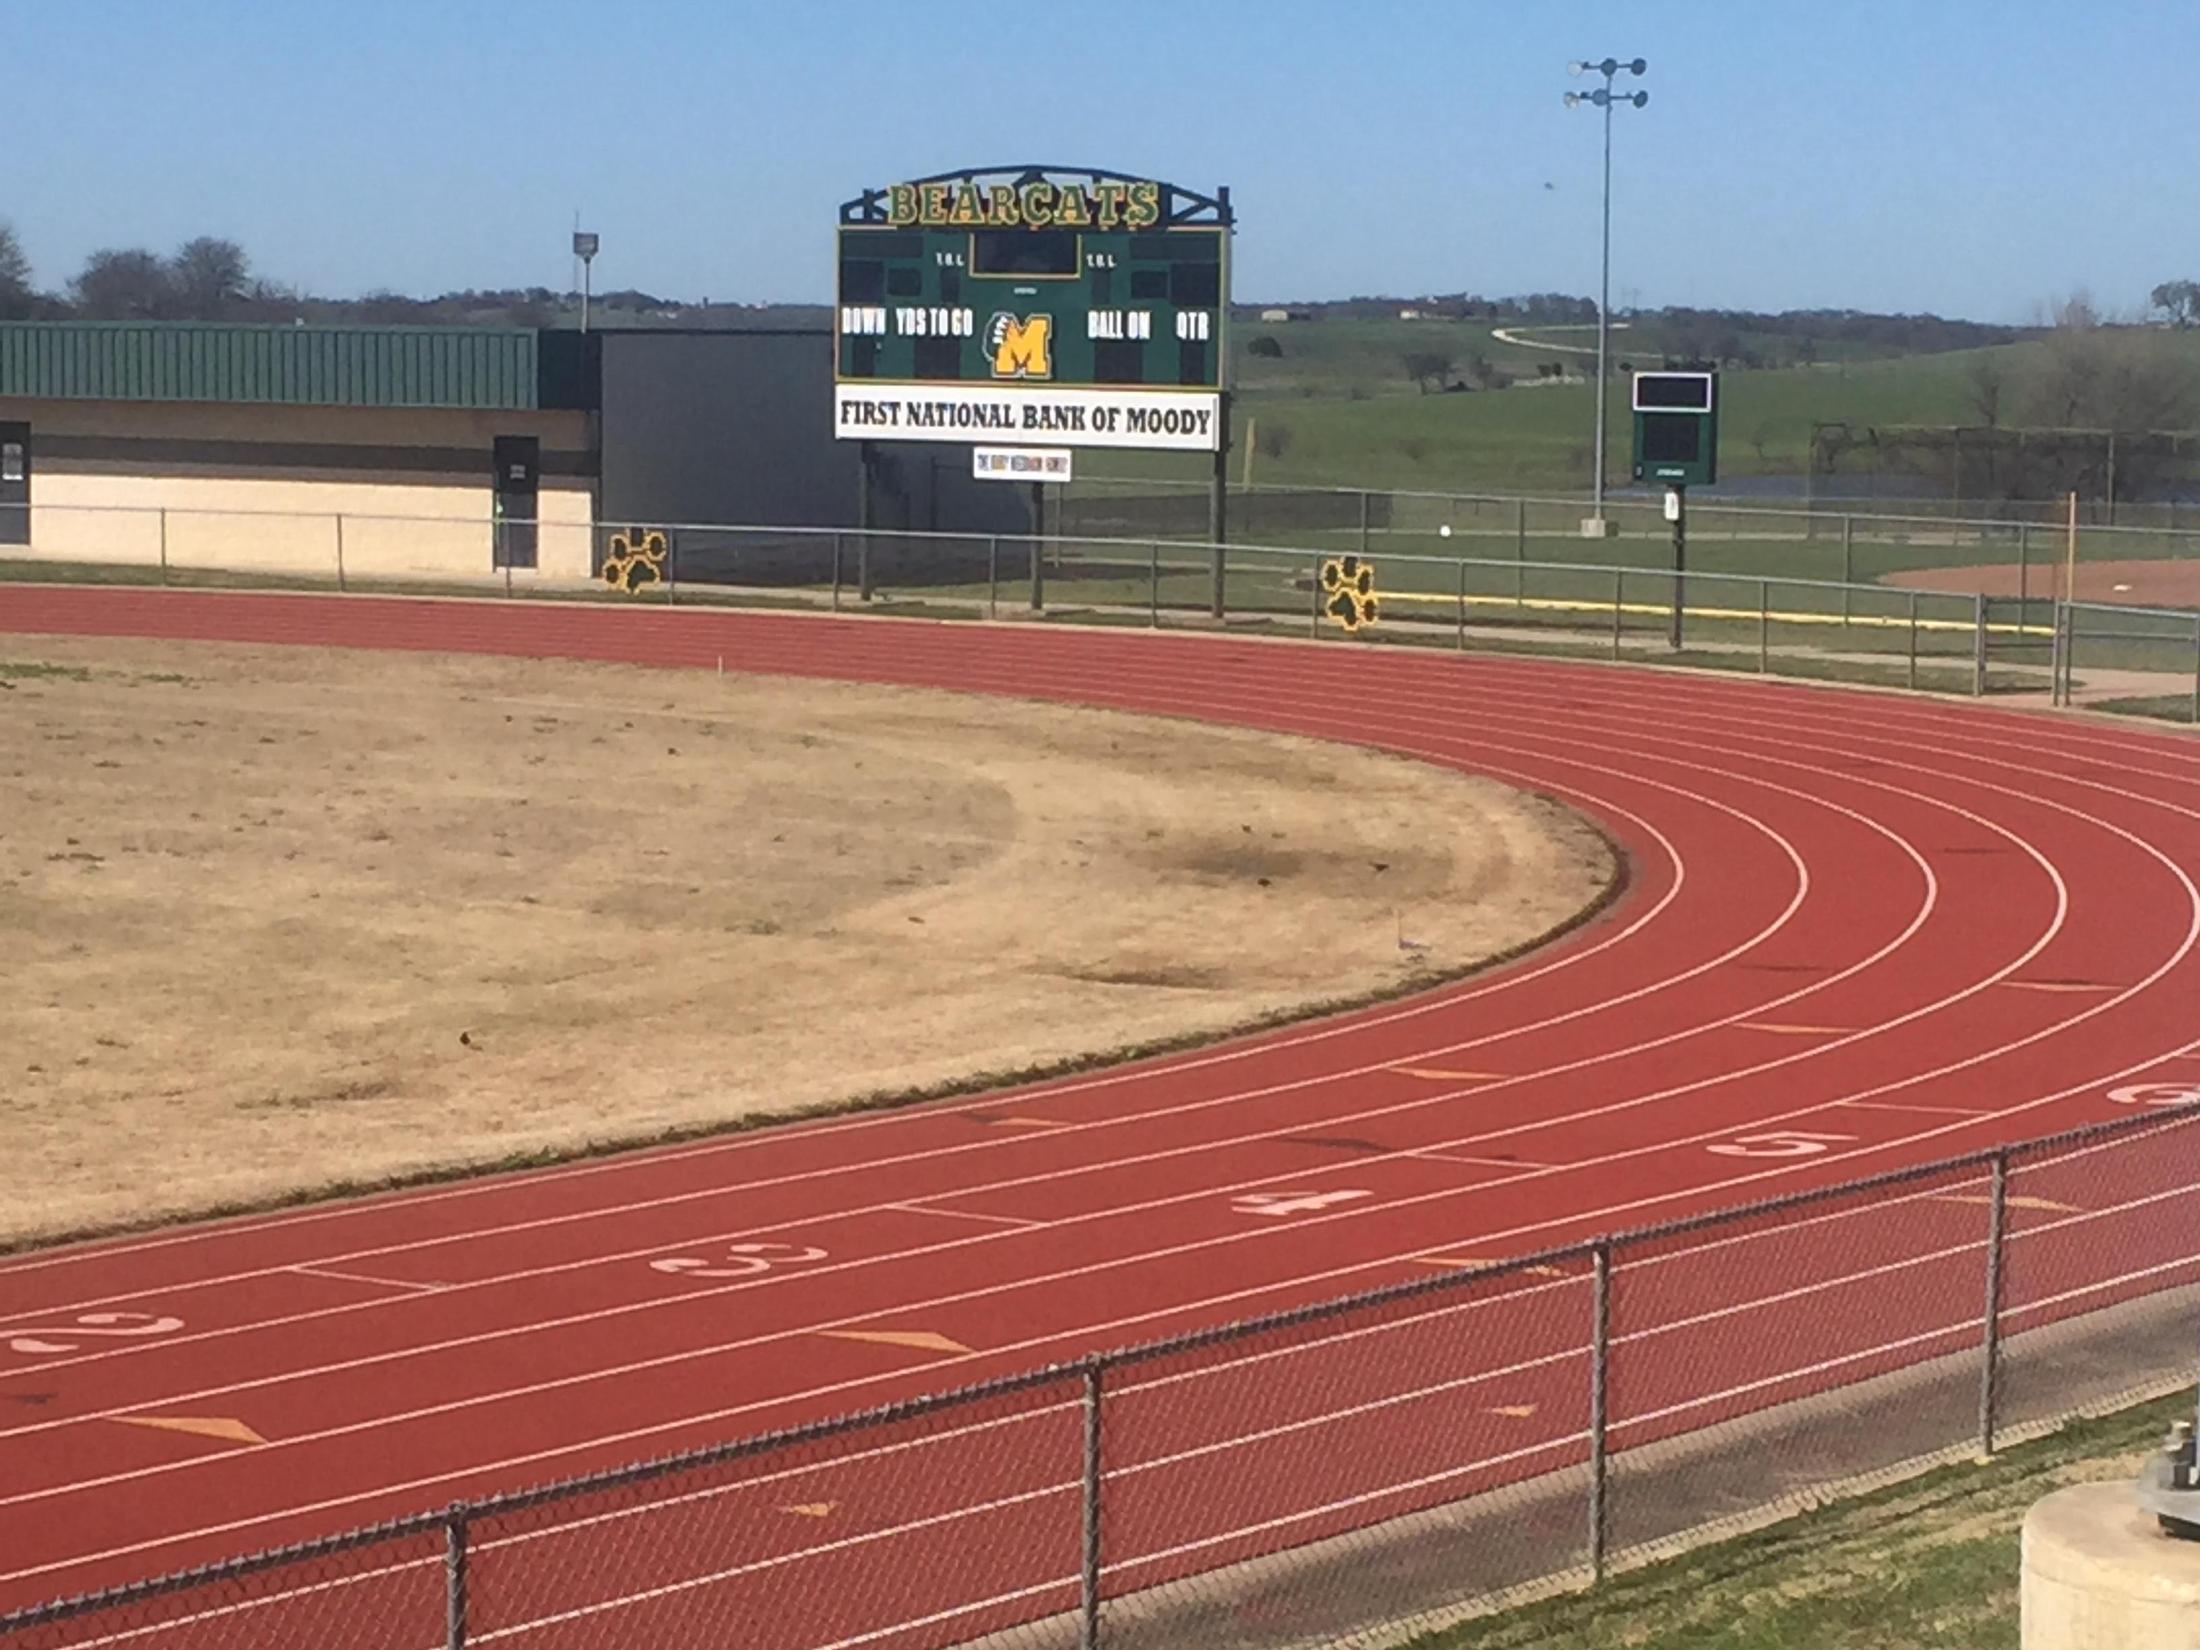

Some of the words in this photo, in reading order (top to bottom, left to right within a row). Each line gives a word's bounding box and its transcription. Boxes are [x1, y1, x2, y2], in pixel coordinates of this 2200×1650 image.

[888, 183, 1159, 225] BEARCATS
[842, 307, 886, 335] DOWN
[896, 308, 926, 336] YDS
[929, 308, 948, 336] TO
[951, 308, 973, 336] GO
[1088, 310, 1123, 339] BALL
[1128, 311, 1150, 339] ON
[1176, 311, 1209, 340] QTR
[992, 313, 1051, 378] M
[841, 400, 900, 426] FIRST
[906, 402, 1016, 429] NATIONAL
[1022, 405, 1086, 431] BANK
[1092, 406, 1121, 432] OF
[1127, 408, 1211, 435] MOODY
[1706, 1131, 1859, 1157] 5
[1230, 1189, 1374, 1215] 4
[650, 1243, 829, 1276] 3
[0, 1312, 185, 1352] 2
